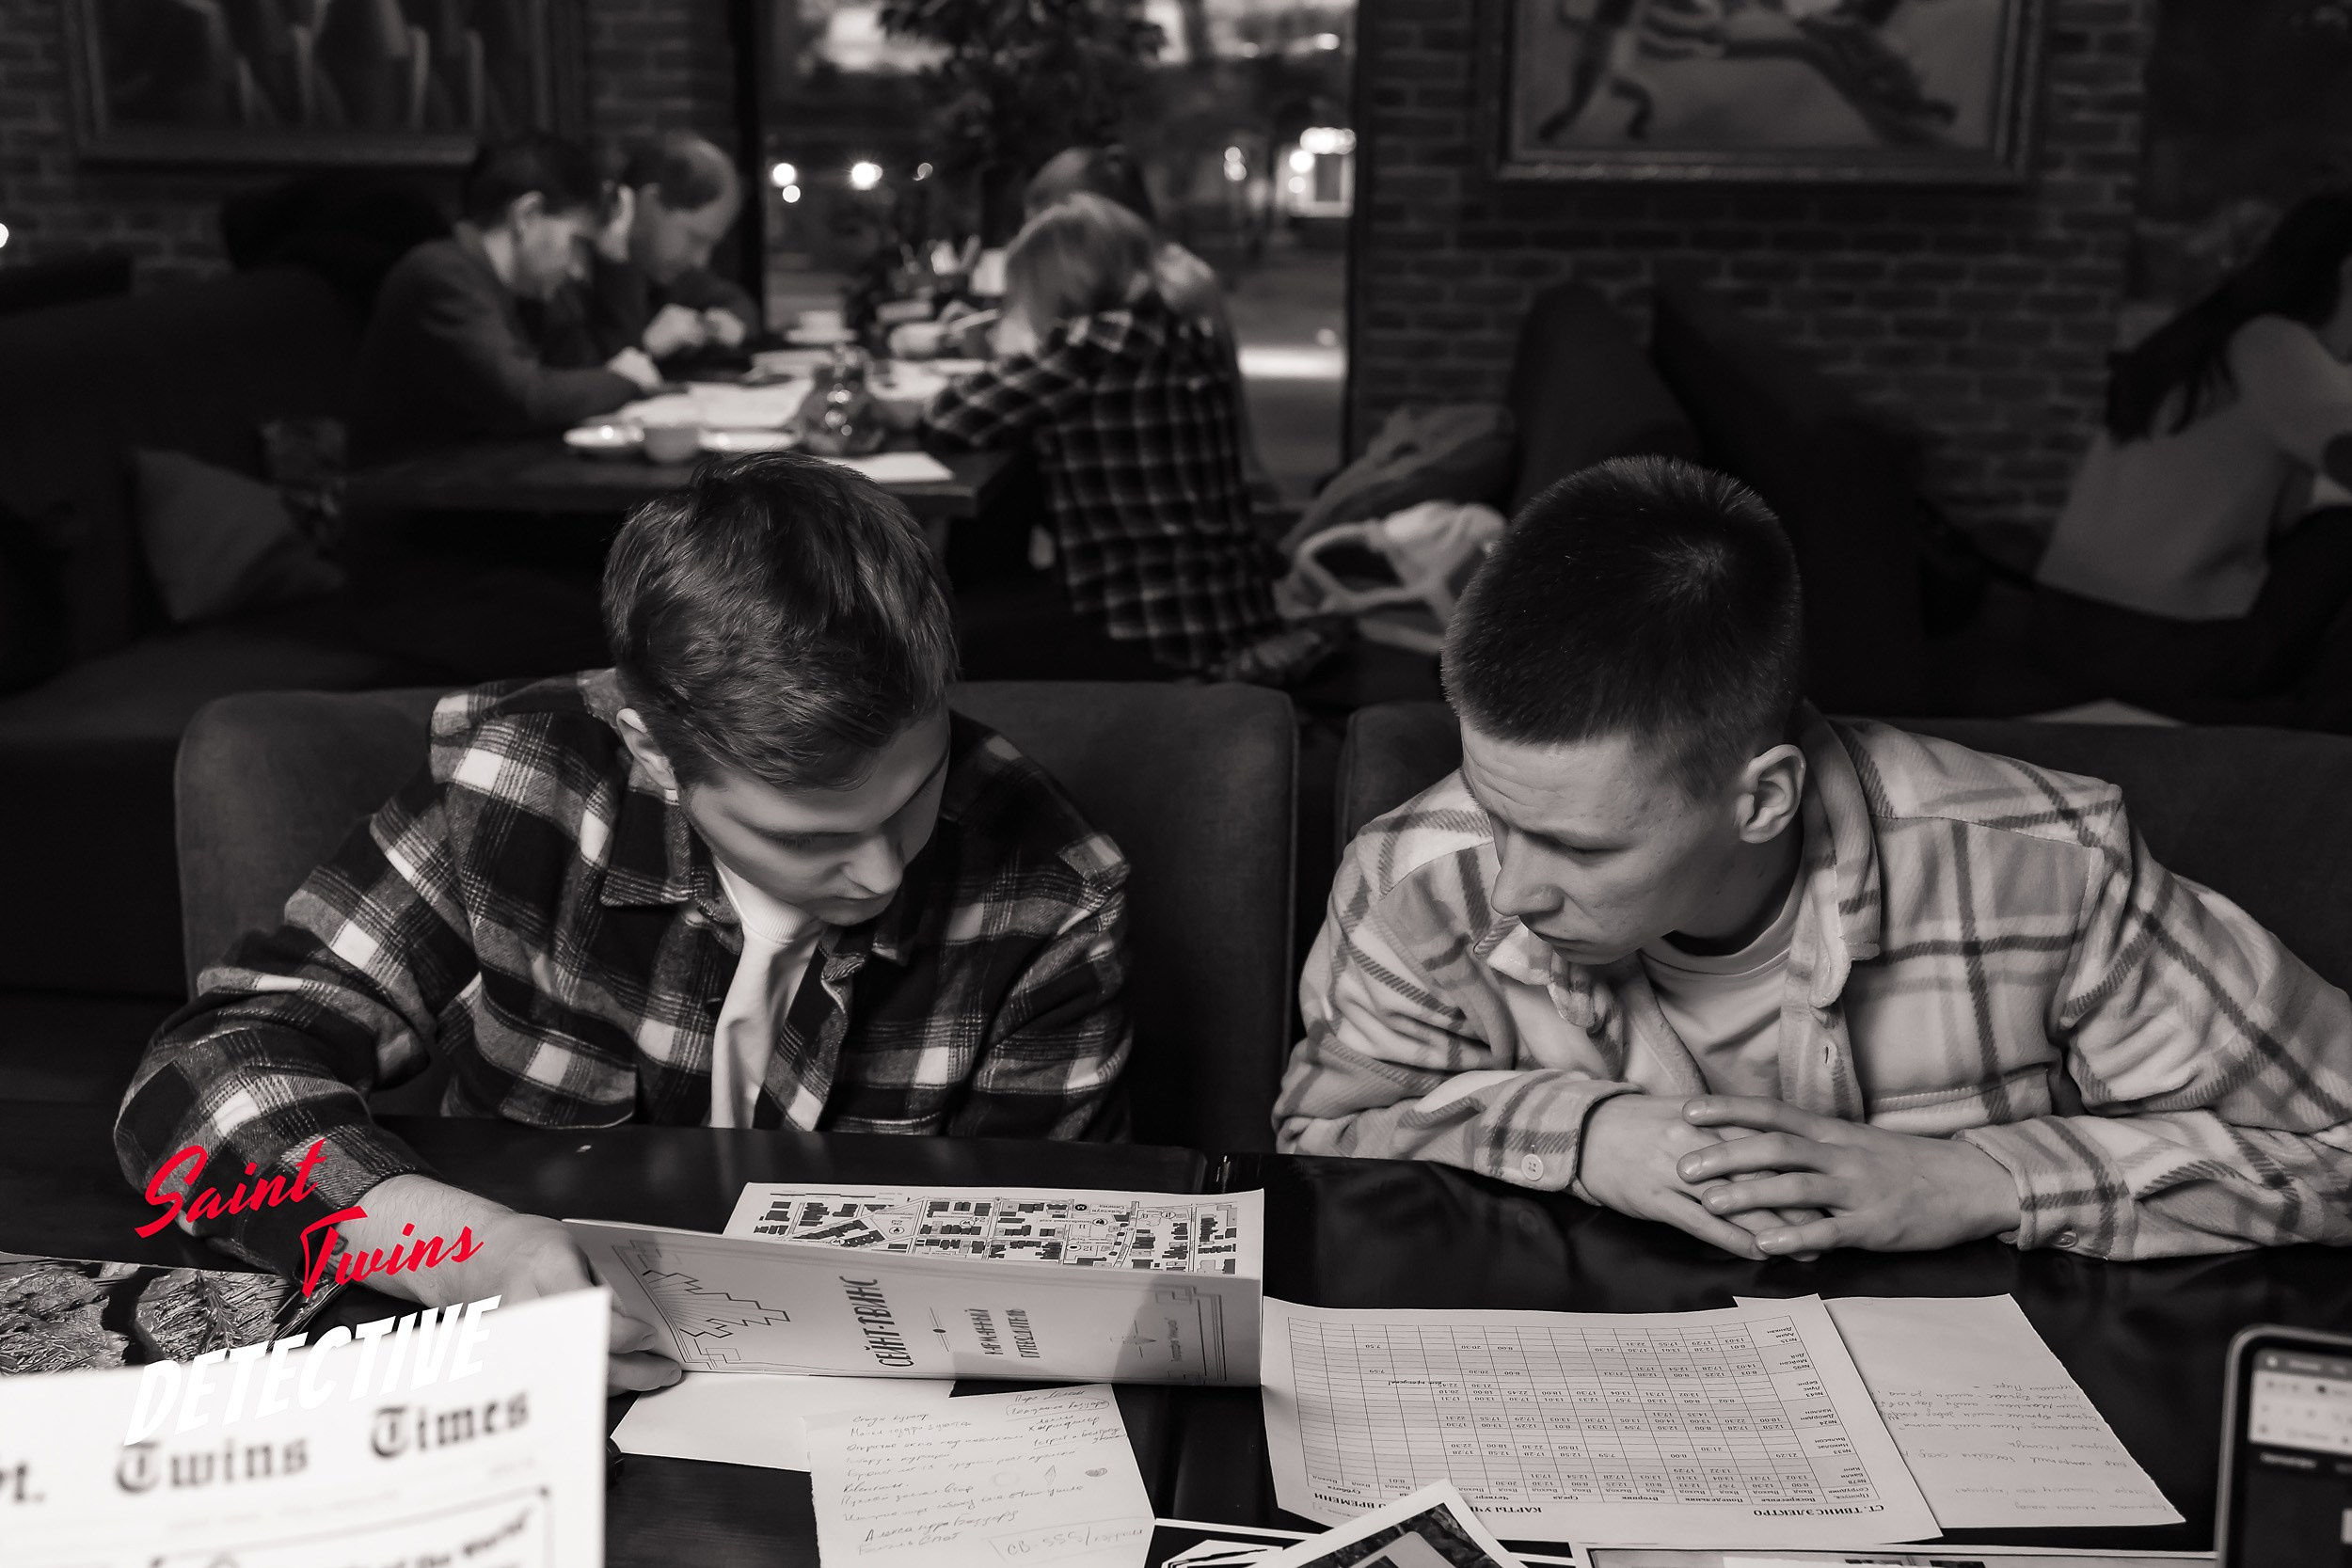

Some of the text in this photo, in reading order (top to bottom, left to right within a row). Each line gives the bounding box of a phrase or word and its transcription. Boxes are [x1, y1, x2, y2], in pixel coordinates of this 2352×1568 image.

[838, 1275, 914, 1368] СЕЙНТ-ТВИНС
[965, 1308, 1004, 1354] КАРМАННЫЙ
[1005, 1308, 1041, 1359] ПУТЕВОДИТЕЛЬ
[114, 1434, 310, 1495] Twins
[369, 1390, 530, 1461] Times
[1314, 1493, 1375, 1509] ВРЕМЕНИ
